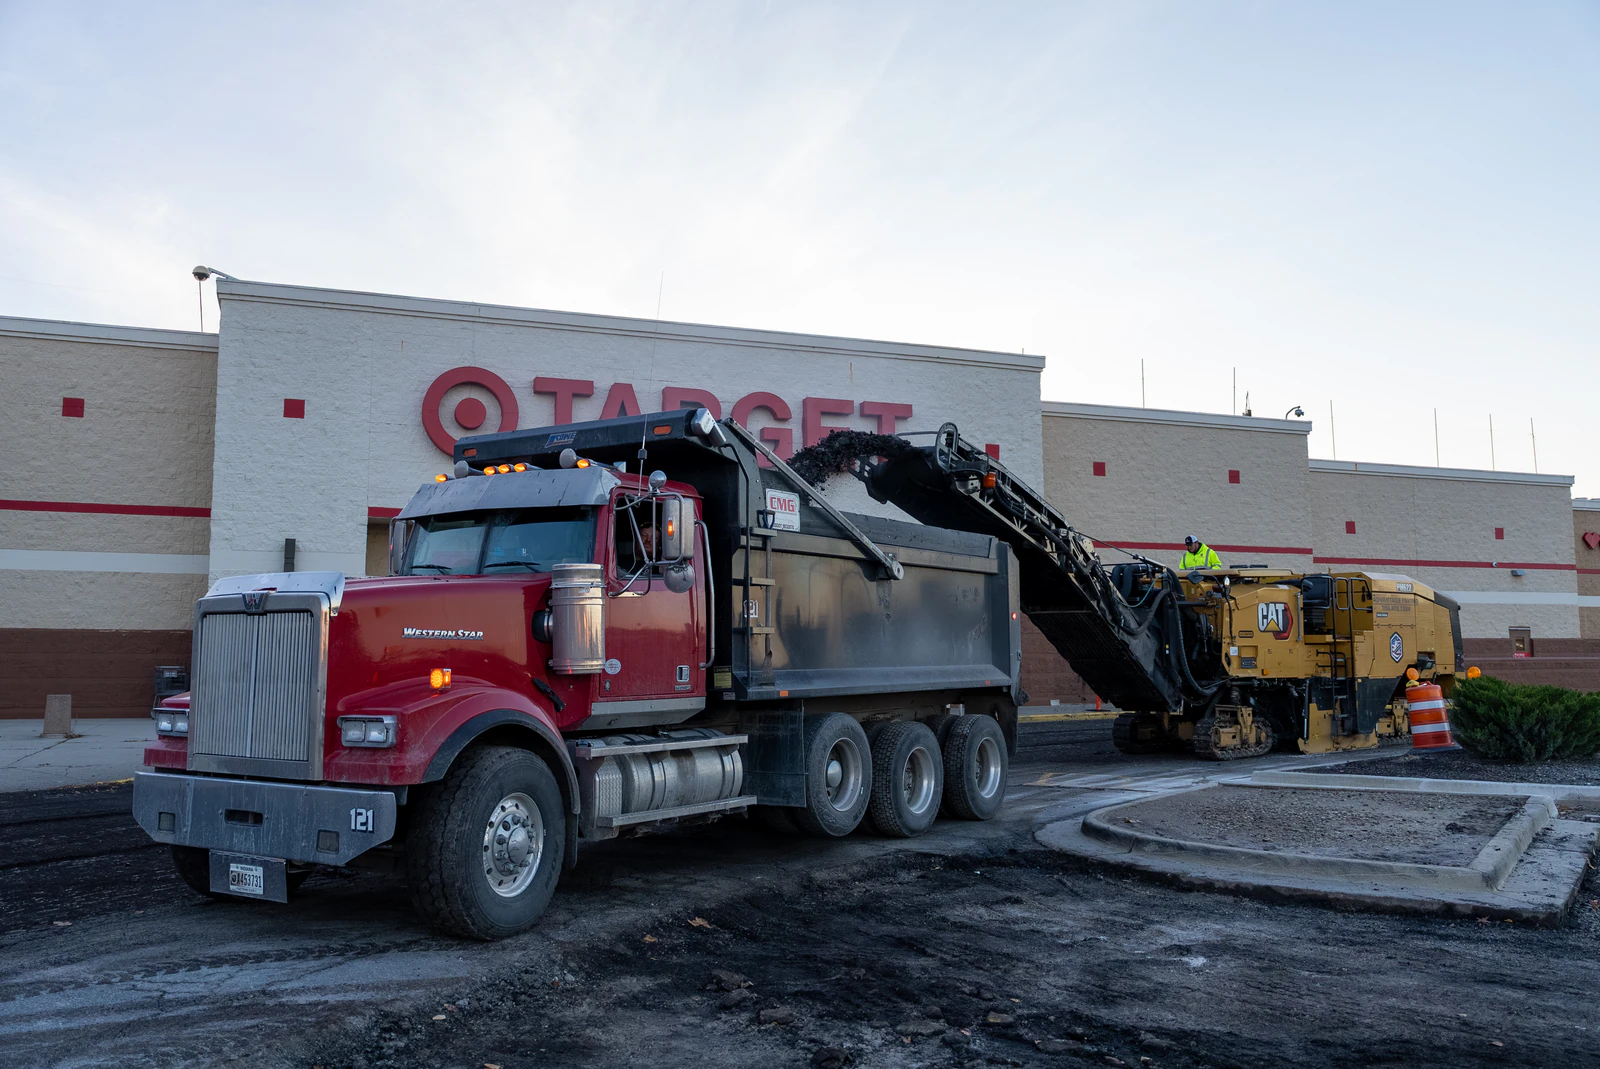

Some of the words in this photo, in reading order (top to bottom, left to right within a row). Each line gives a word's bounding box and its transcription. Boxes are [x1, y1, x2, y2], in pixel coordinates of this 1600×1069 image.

[769, 496, 795, 513] CMG
[1258, 602, 1285, 632] CAT
[402, 627, 457, 639] WESTERN
[457, 629, 484, 640] STAR
[350, 807, 374, 832] 121
